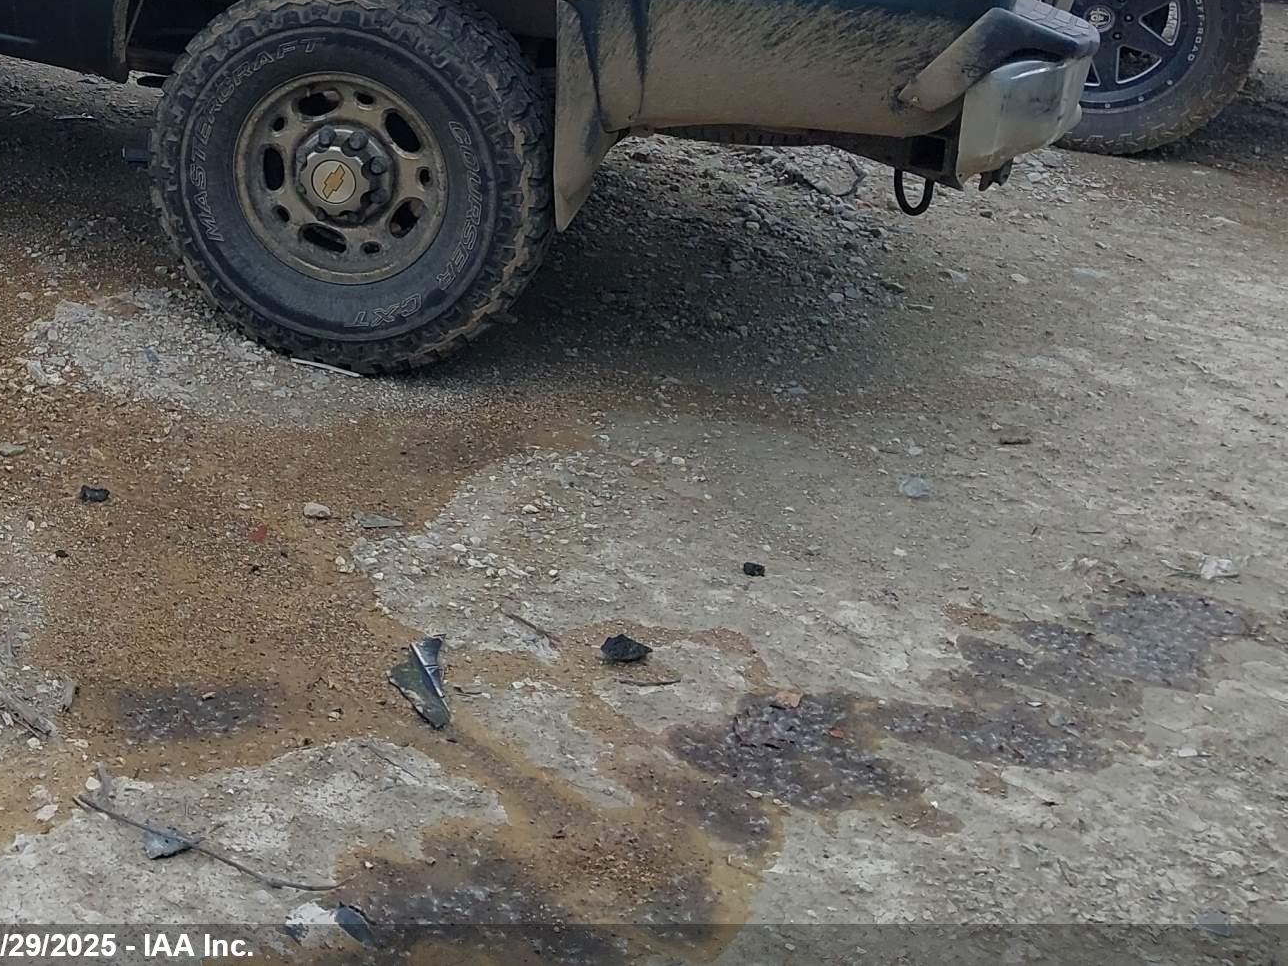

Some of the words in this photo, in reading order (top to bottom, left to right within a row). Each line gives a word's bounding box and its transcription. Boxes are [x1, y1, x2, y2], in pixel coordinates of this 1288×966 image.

[189, 36, 328, 243] MASTERCRAFT
[435, 120, 484, 291] COURSER
[344, 292, 423, 328] CXT
